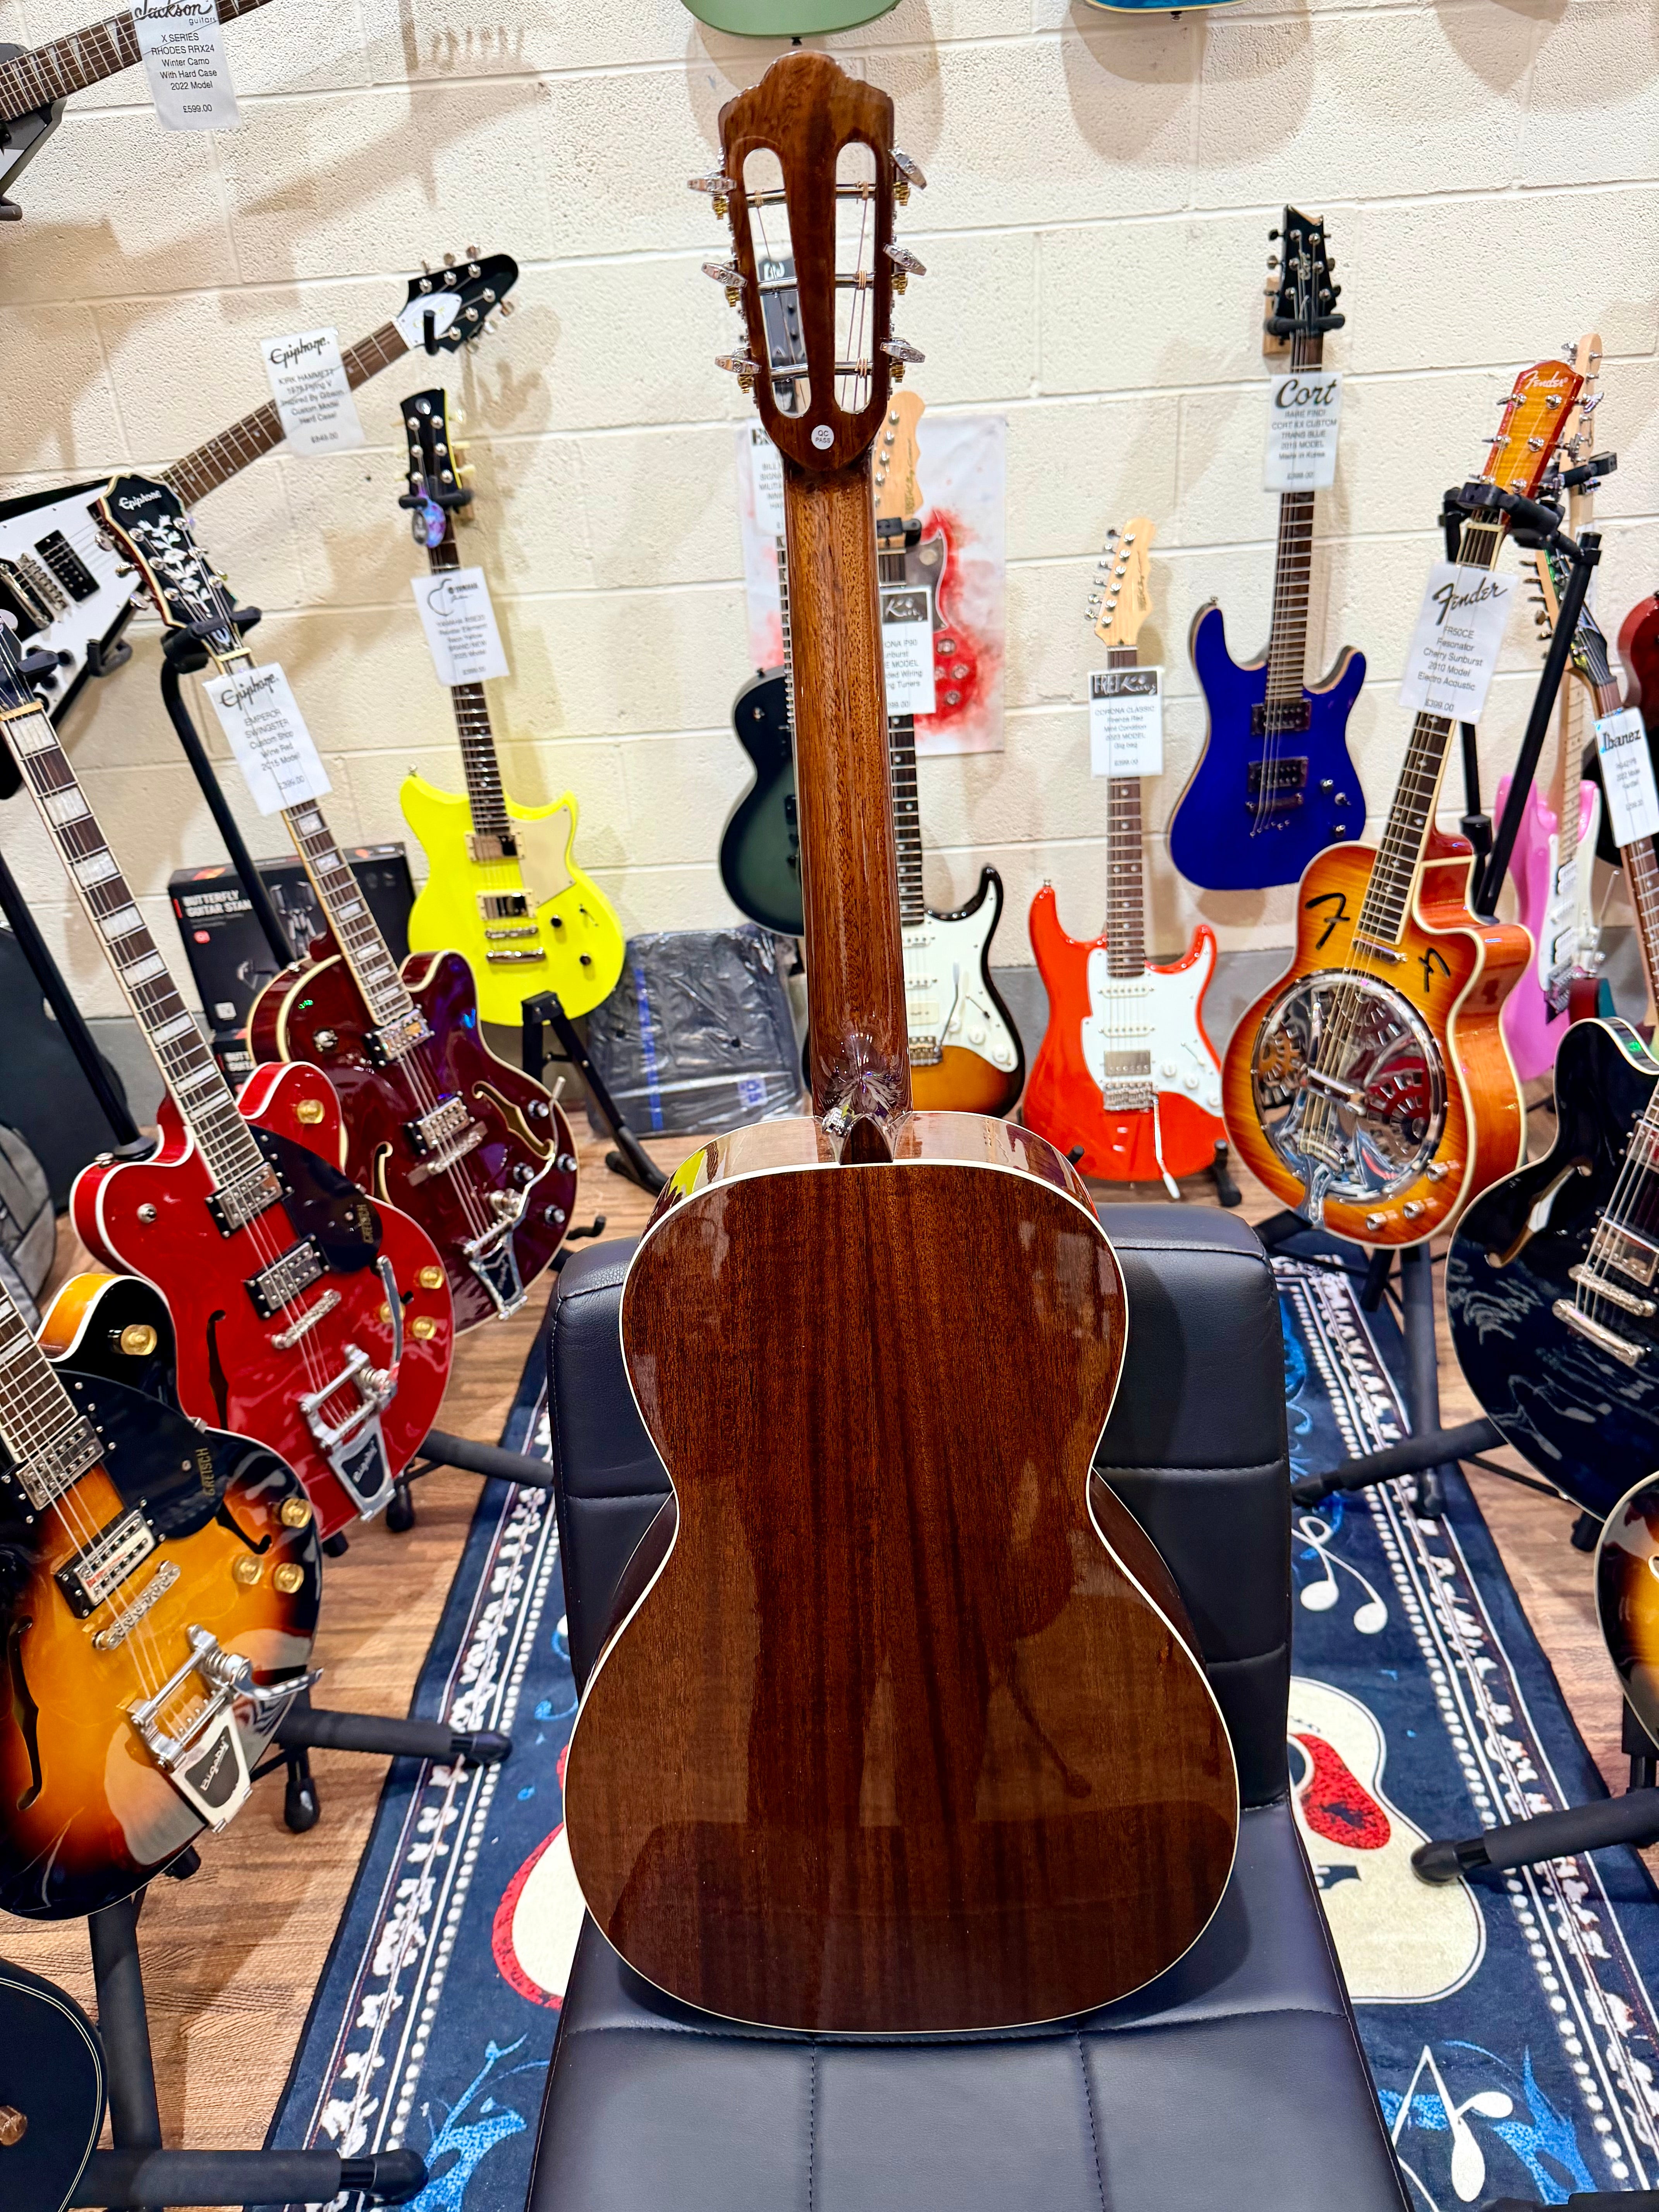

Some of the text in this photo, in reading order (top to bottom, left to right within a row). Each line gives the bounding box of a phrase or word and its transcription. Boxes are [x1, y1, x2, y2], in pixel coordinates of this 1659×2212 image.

[134, 0, 213, 19] Jackson
[189, 17, 216, 26] guitars
[161, 33, 199, 43] X SERIES
[151, 44, 214, 55] RHODES RRX24
[191, 81, 213, 89] Model
[183, 104, 212, 113] £599.00
[1522, 370, 1565, 390] Fender
[1275, 378, 1337, 409] Cort
[1305, 418, 1337, 429] CUSTOM
[1299, 441, 1324, 449] MODEL
[118, 490, 162, 510] Epiphone
[1432, 576, 1508, 626] Fender
[885, 639, 902, 647] ONA
[892, 659, 919, 668] MODEL
[1424, 647, 1483, 667] Cherry Sunburst
[1447, 665, 1471, 678] Model
[1418, 671, 1475, 691] Electro Acoustic
[244, 708, 282, 726] EMPEROR
[245, 718, 290, 739] SWINGSTER
[1602, 728, 1641, 751] Ibanez
[182, 890, 239, 907] BUTTERFLY
[185, 899, 253, 917] GUITAR STAN
[195, 1448, 215, 1496] GRETSCH
